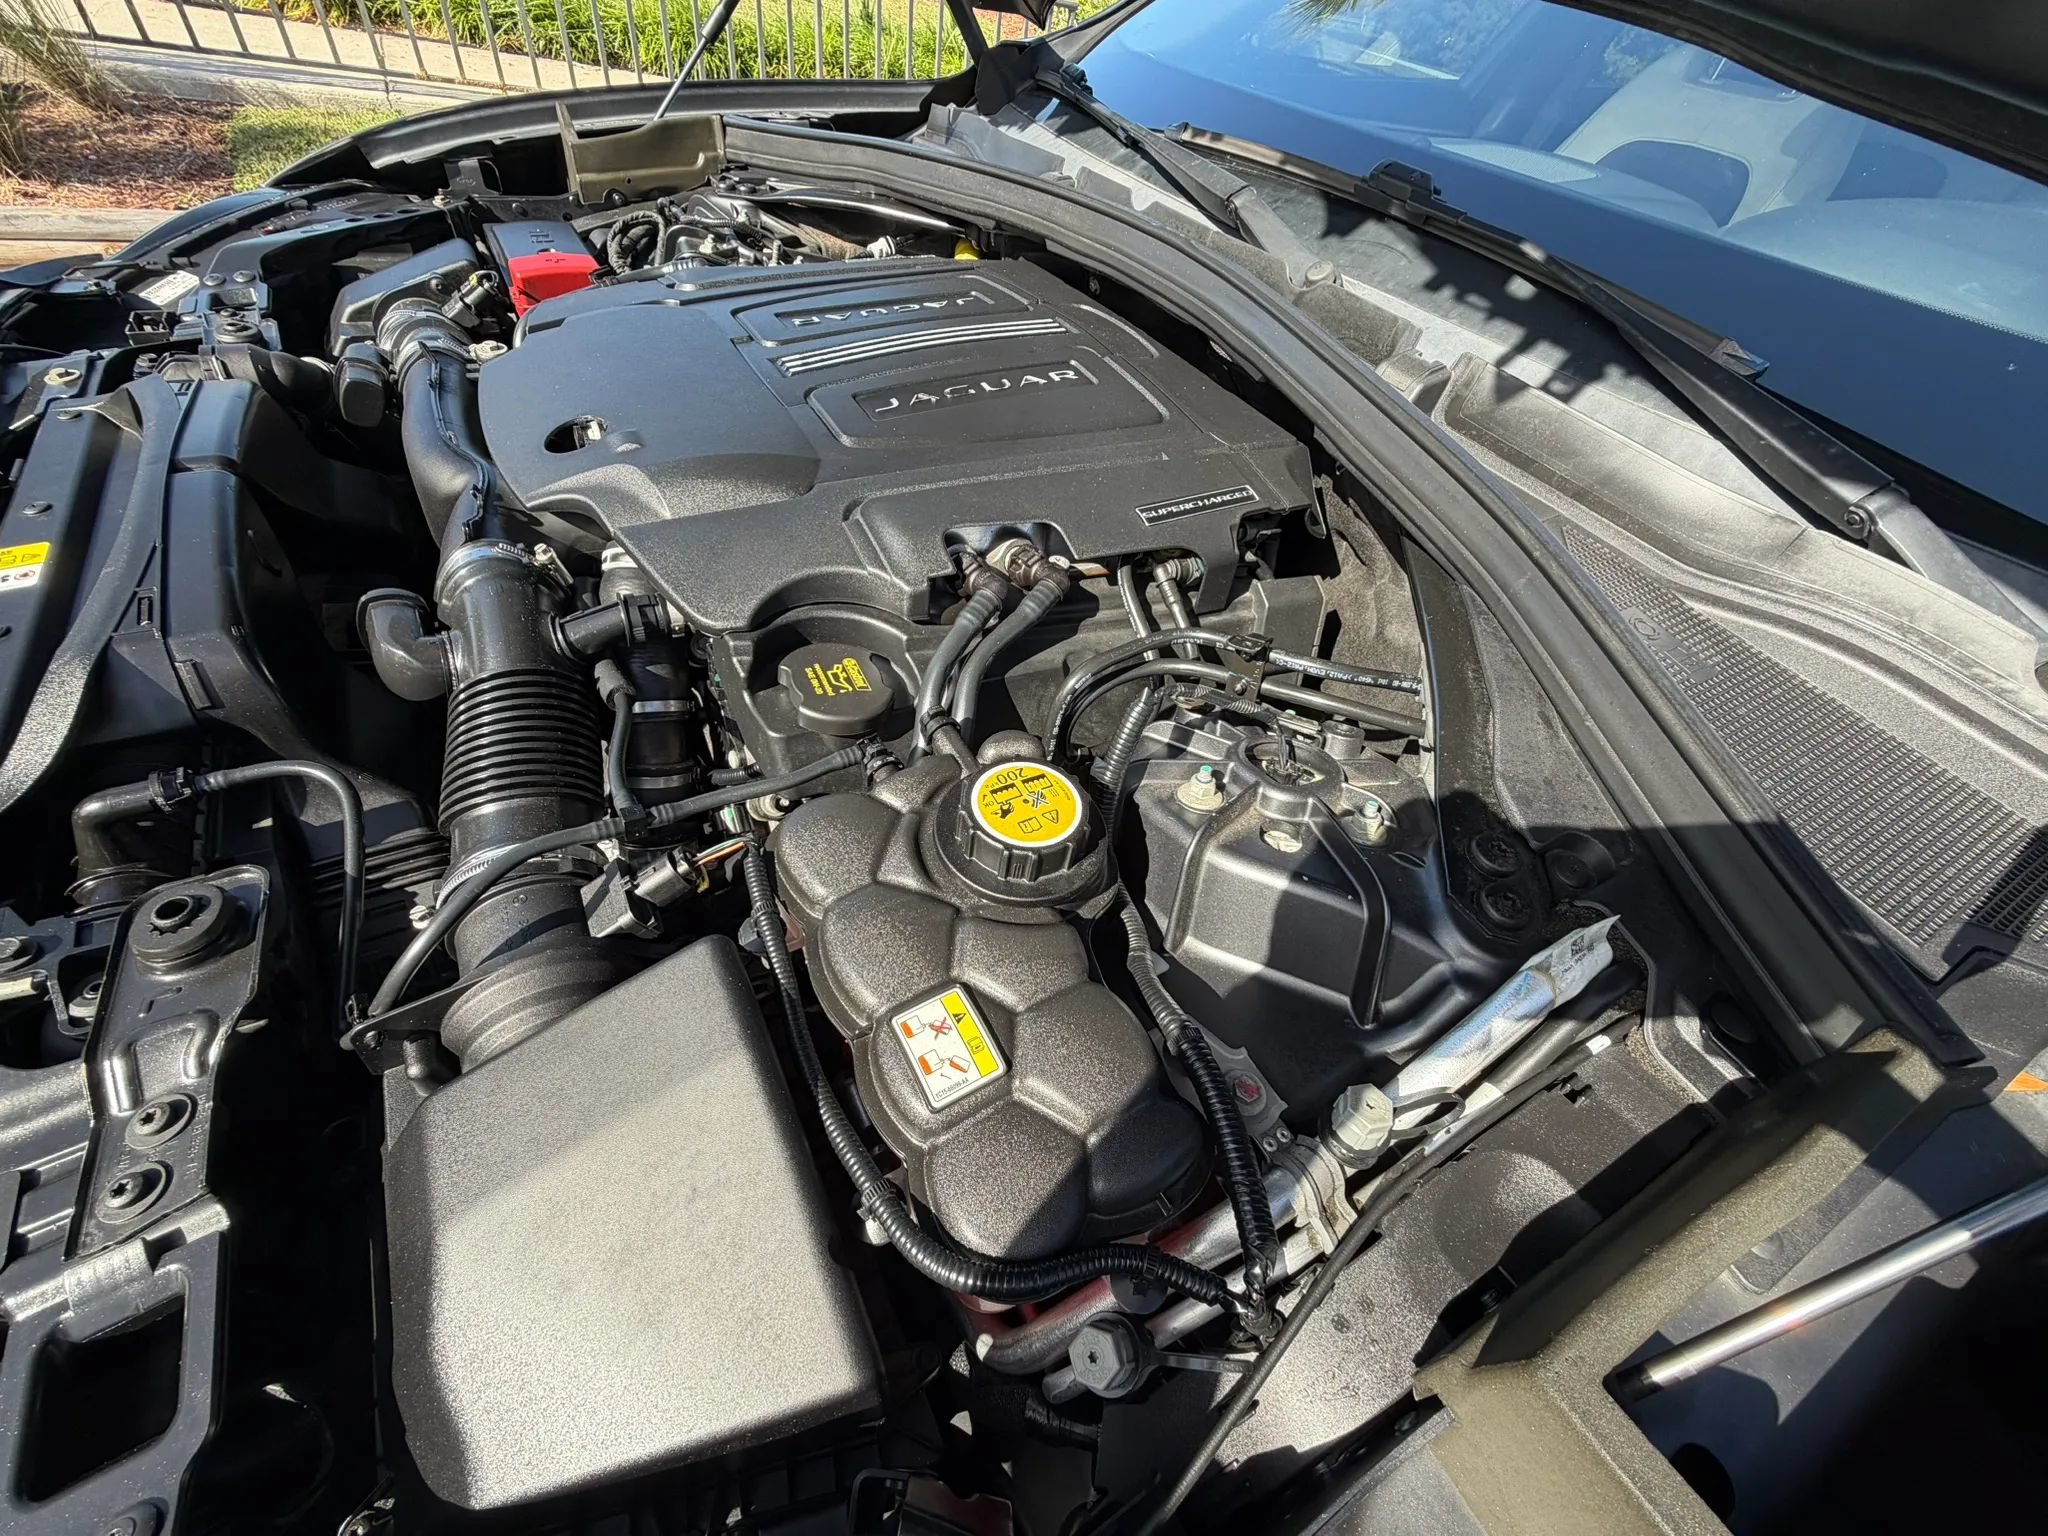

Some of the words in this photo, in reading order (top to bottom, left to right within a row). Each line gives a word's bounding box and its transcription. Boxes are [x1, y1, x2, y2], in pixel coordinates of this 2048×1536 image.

[791, 297, 975, 328] JAGUAR
[874, 369, 1080, 413] JAGUAR
[1142, 490, 1253, 518] SUPERCHARGED
